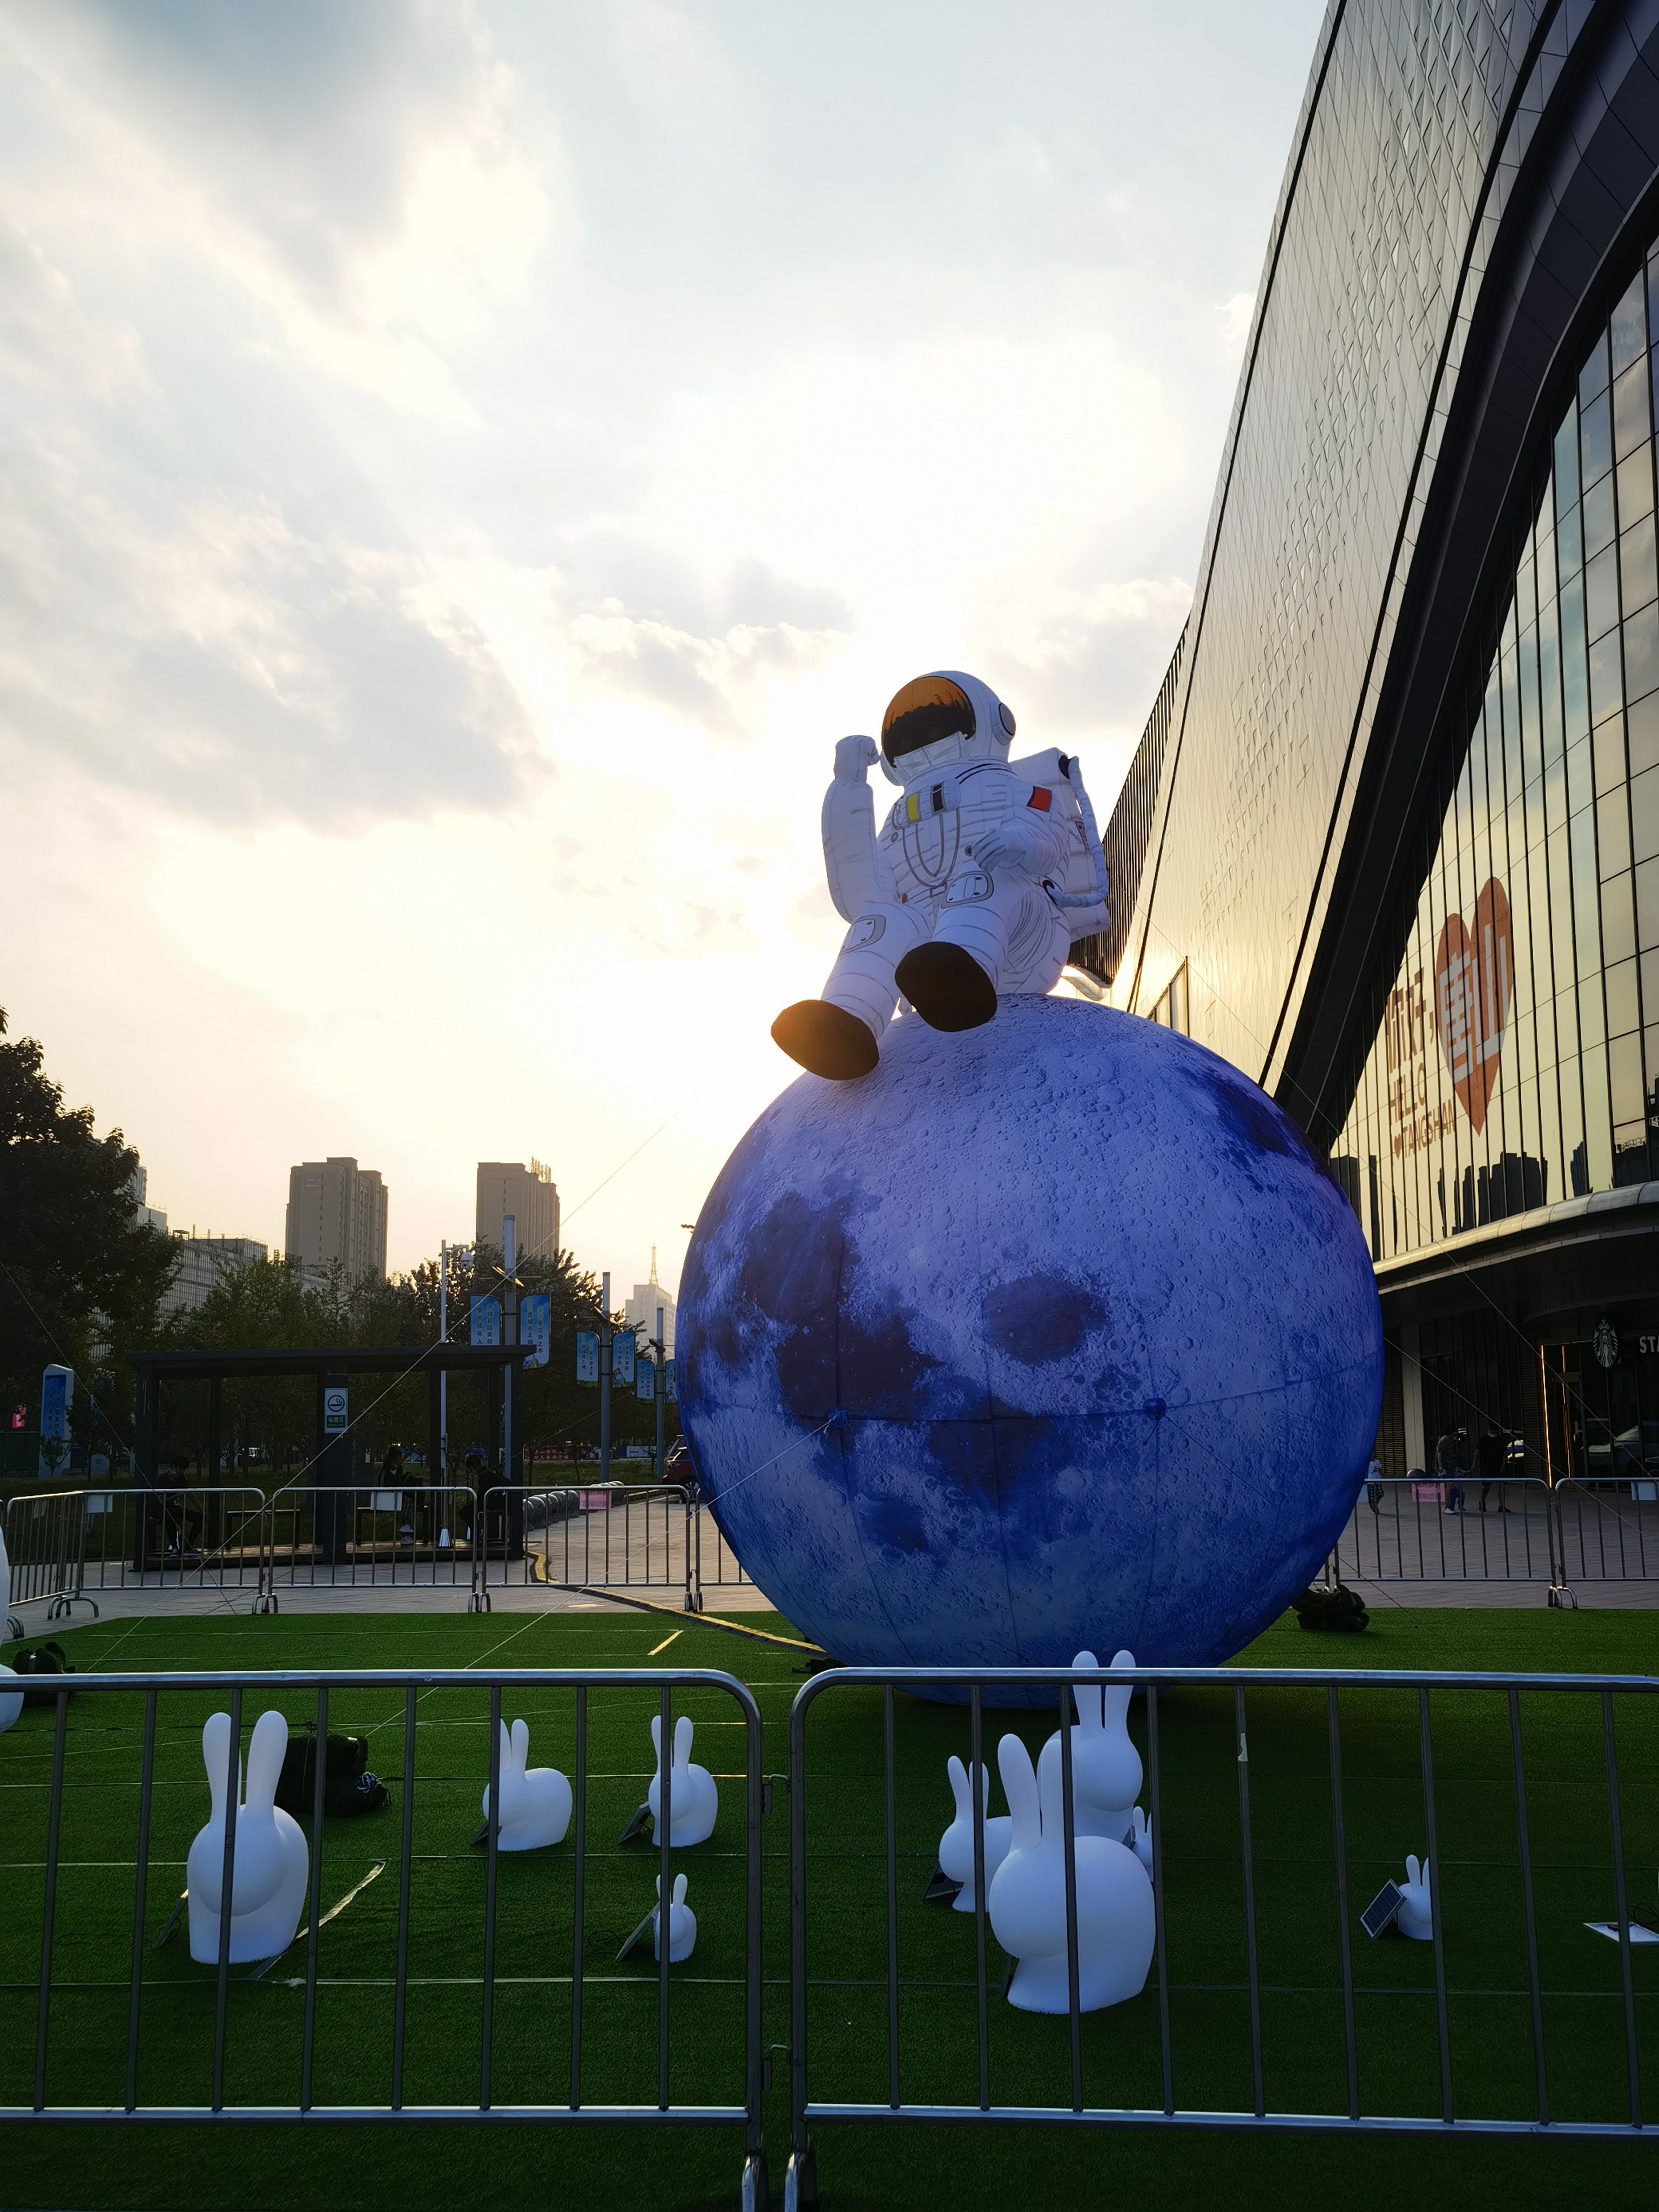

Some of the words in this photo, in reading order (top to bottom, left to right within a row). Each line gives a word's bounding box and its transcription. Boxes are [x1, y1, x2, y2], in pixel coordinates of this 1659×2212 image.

[1439, 923, 1508, 1084] 唐山
[1388, 1062, 1427, 1124] HELLO
[1401, 1098, 1455, 1158] TANGSHAN
